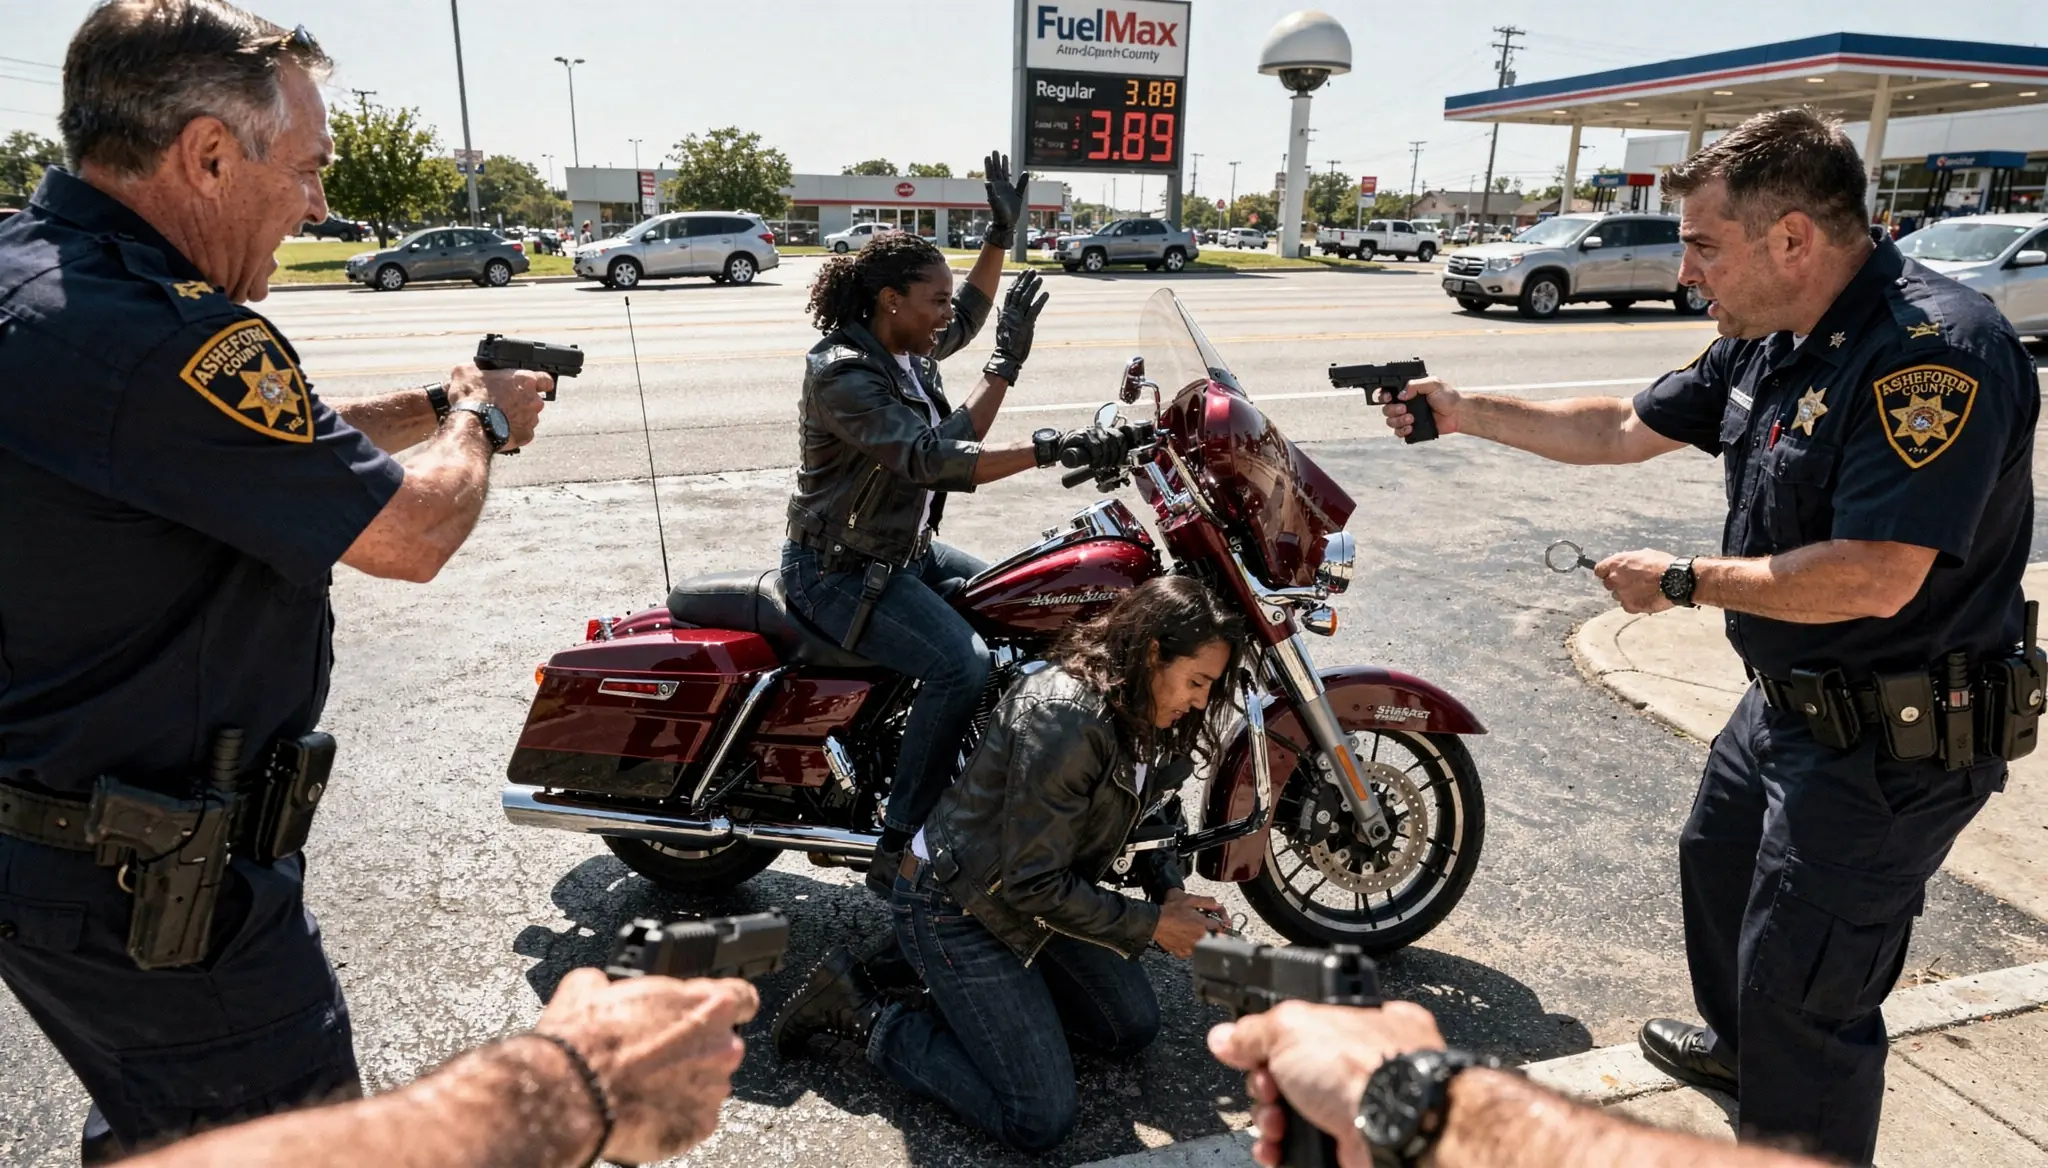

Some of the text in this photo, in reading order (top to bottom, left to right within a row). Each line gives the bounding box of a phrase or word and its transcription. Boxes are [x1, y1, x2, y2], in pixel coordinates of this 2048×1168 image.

[1037, 5, 1178, 47] FuelMax
[1036, 80, 1176, 107] Regular 3.89
[1088, 110, 1174, 161] 3.89
[1902, 383, 1954, 396] COUNTY
